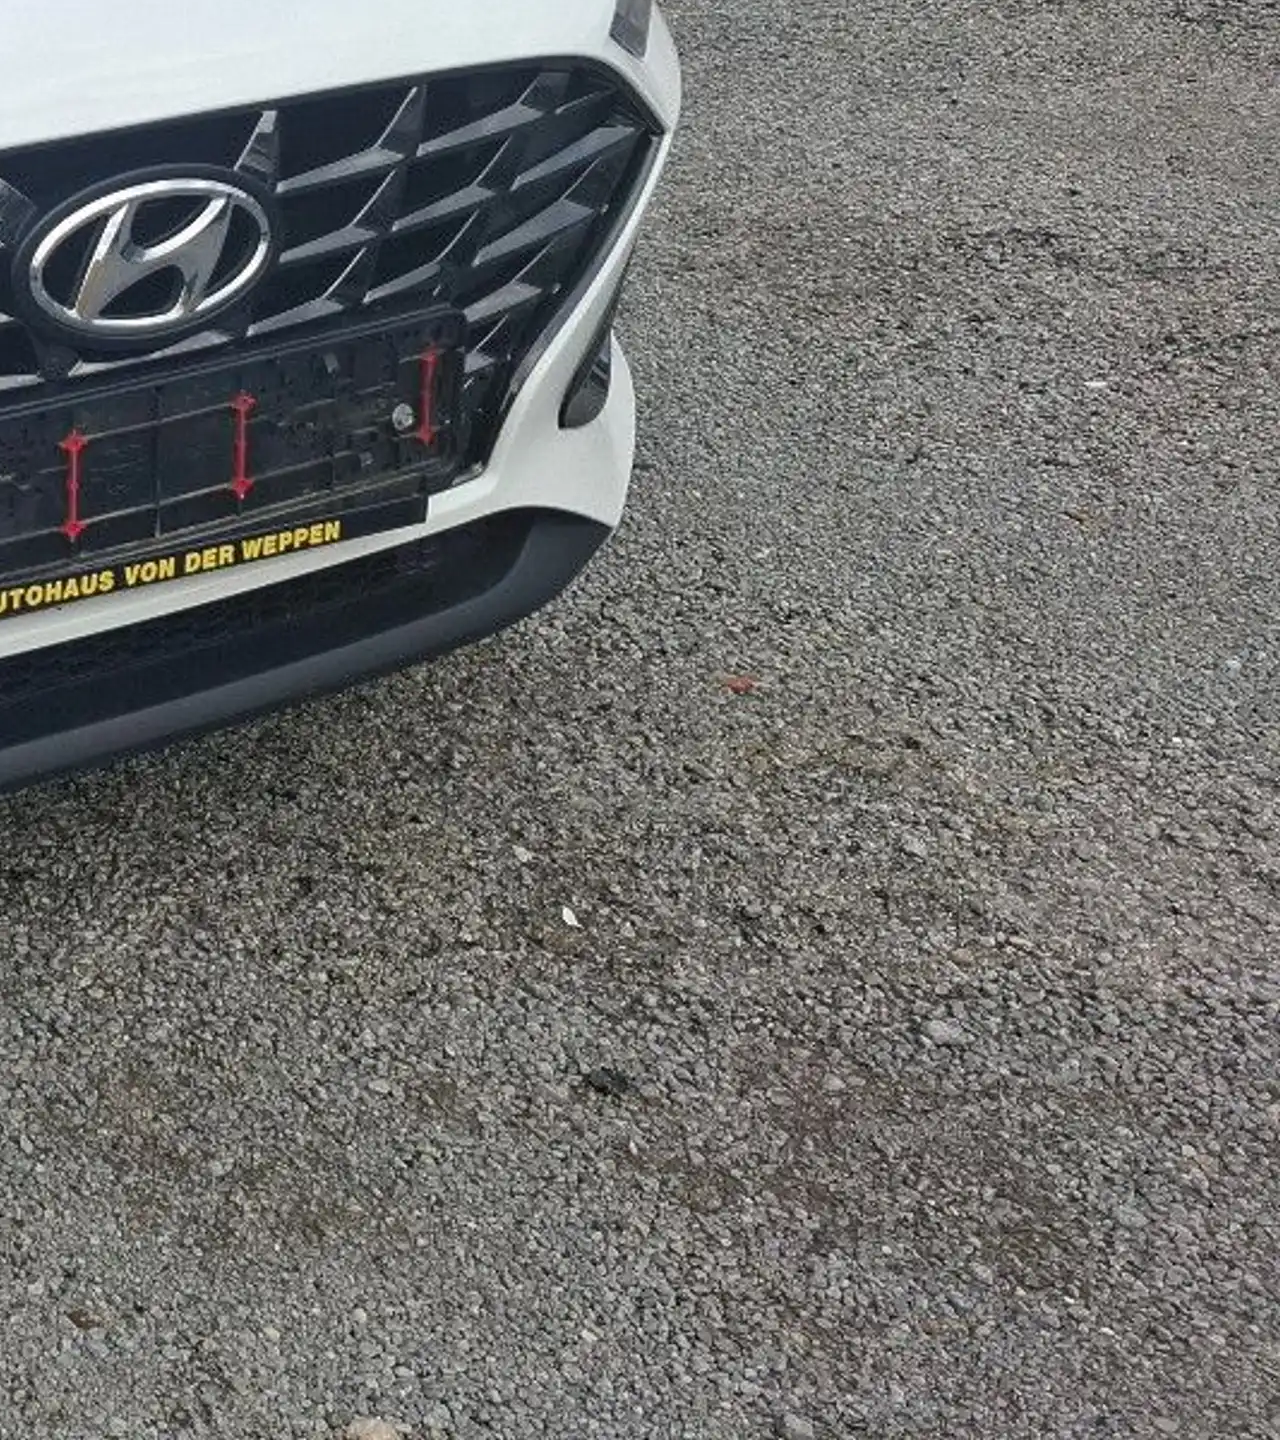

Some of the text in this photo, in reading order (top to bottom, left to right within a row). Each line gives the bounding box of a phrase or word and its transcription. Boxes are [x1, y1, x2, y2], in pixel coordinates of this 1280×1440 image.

[125, 556, 176, 588] VON
[185, 543, 235, 572] DER
[242, 520, 342, 560] WEPPEN
